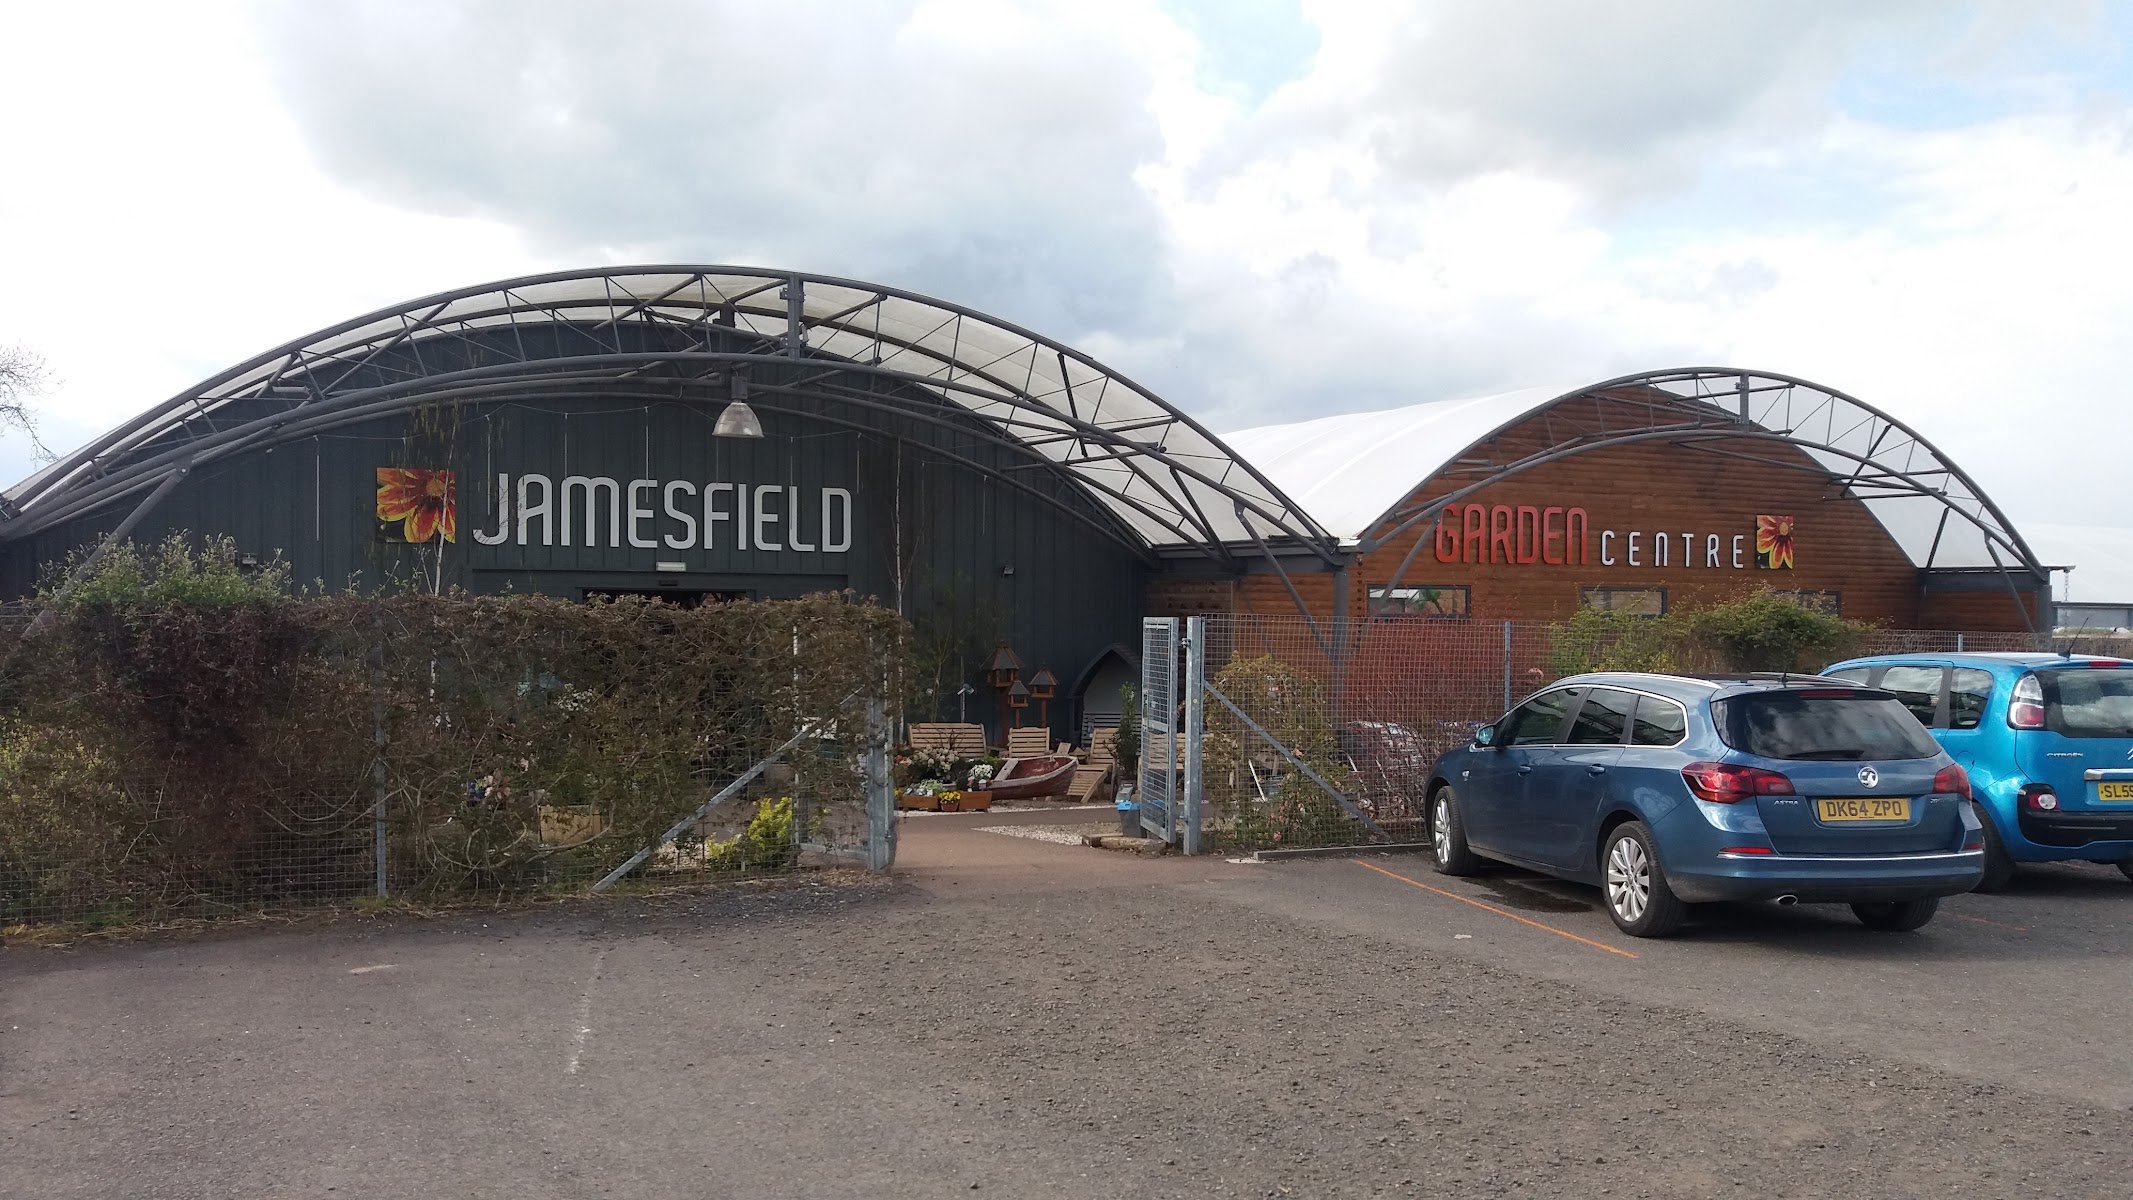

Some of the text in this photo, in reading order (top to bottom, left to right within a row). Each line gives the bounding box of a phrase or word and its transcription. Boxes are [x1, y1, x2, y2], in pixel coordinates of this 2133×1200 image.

[473, 473, 852, 553] JAMESFIELD
[1435, 503, 1744, 568] GARDEN CENTRE
[1826, 801, 1868, 816] DK64
